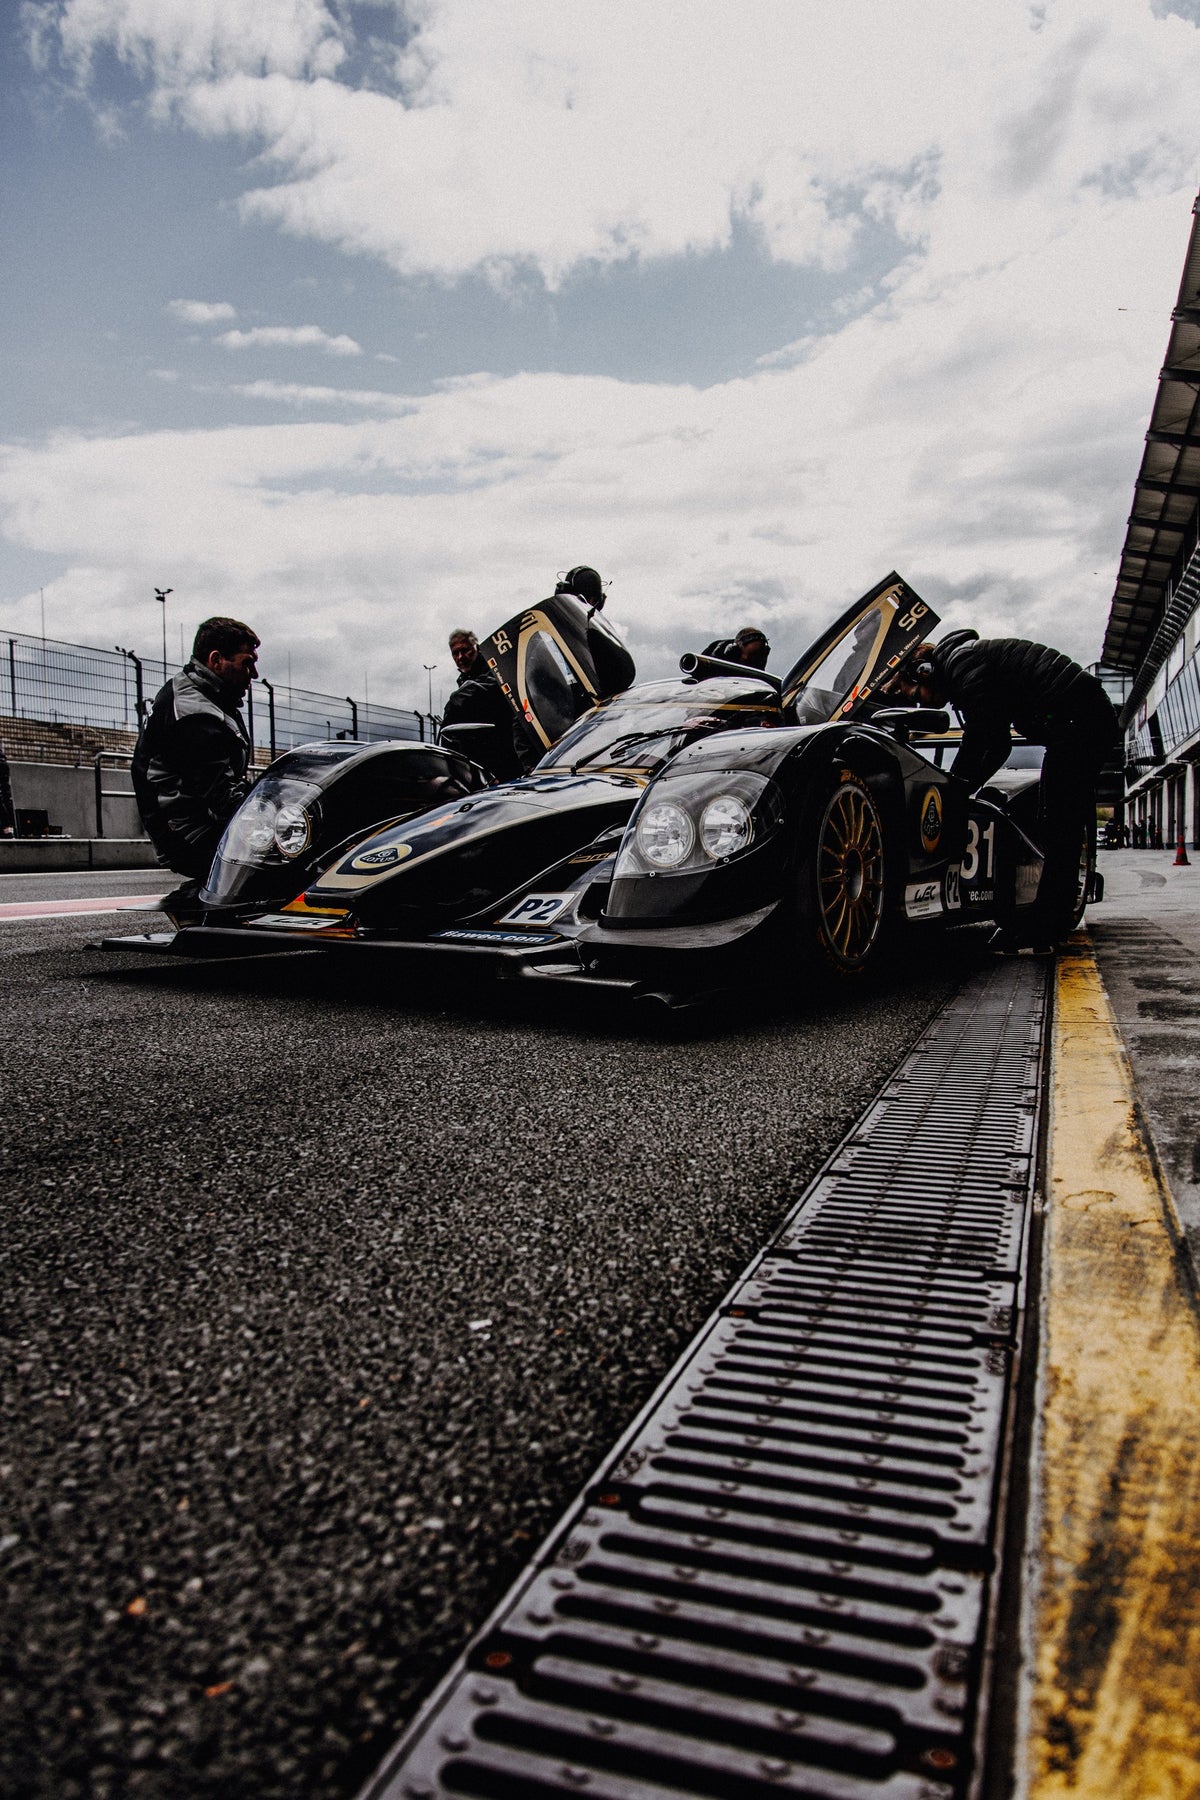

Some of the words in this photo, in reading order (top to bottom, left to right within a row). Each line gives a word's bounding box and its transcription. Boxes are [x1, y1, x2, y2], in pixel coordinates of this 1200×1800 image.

[898, 602, 929, 632] SG
[491, 630, 513, 655] SG
[361, 855, 395, 864] LOTUS
[960, 819, 995, 880] 31
[914, 885, 937, 903] WEC
[946, 870, 960, 904] P2
[508, 899, 563, 921] P2
[440, 930, 545, 943] fiawec.com
